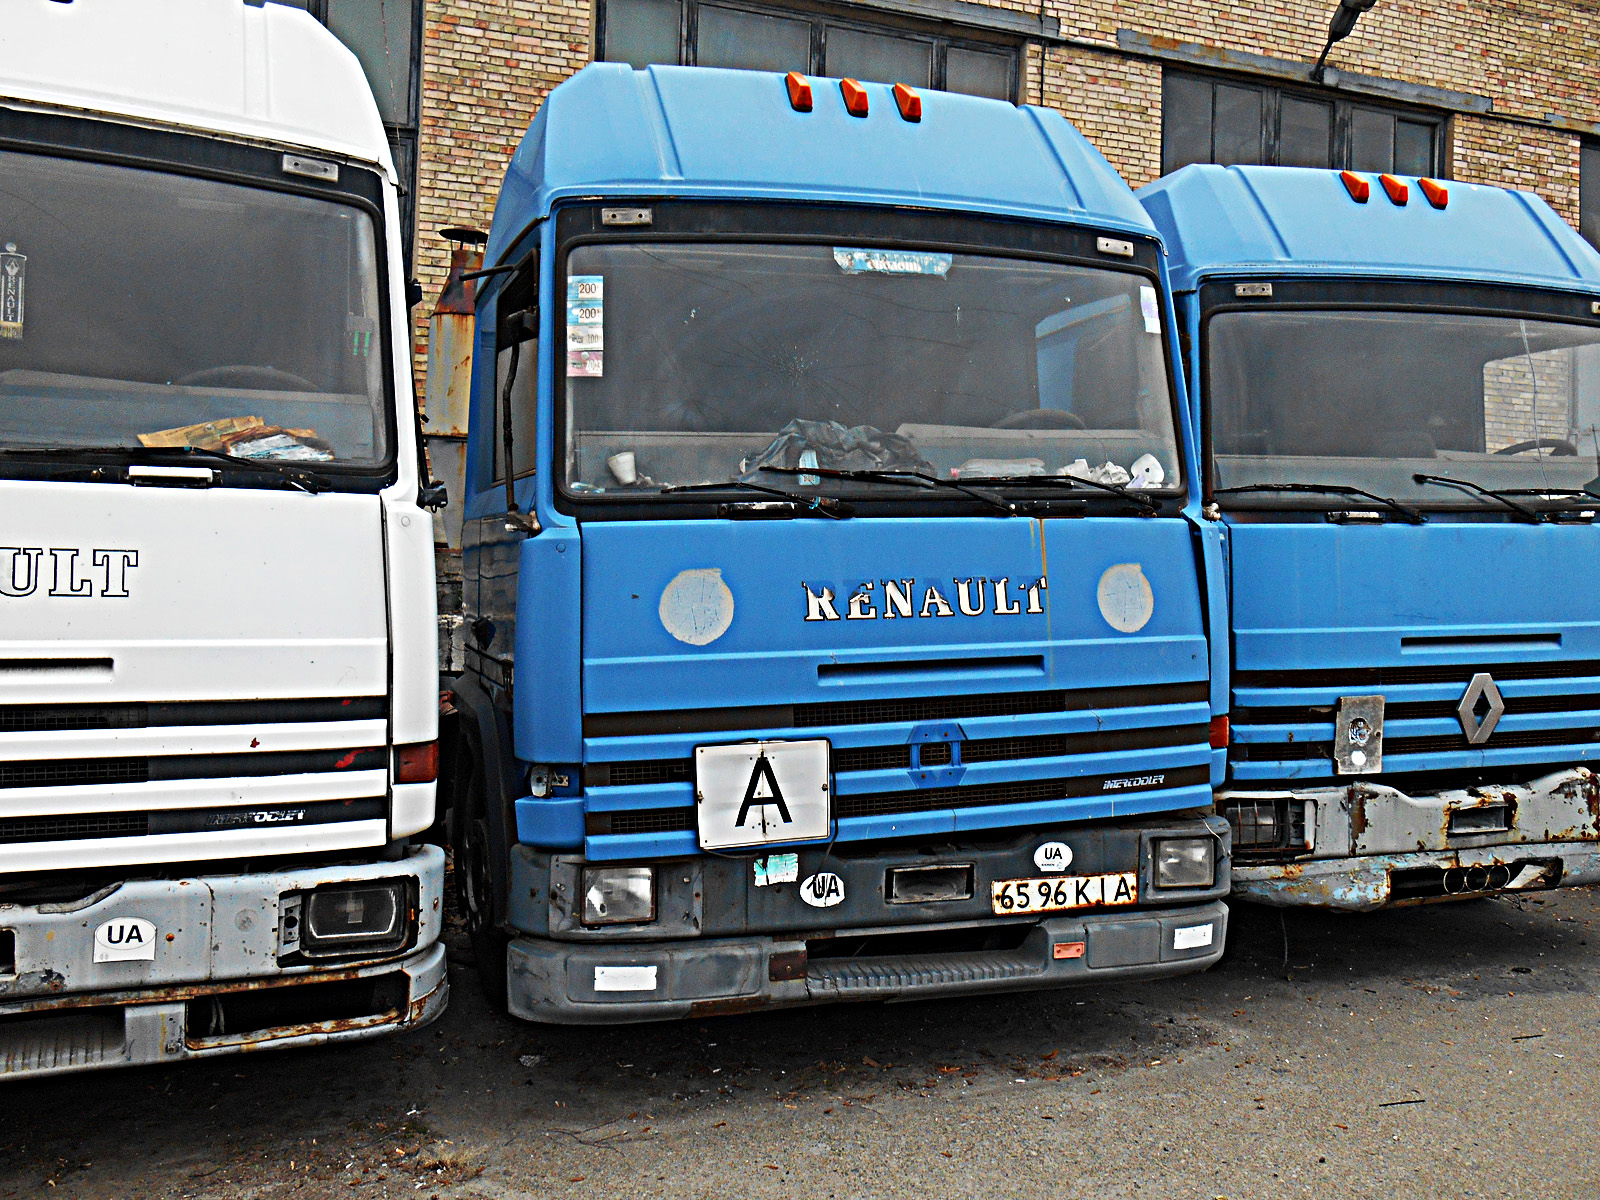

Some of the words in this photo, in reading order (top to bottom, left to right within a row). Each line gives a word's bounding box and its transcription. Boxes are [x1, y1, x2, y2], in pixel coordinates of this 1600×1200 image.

[0, 547, 138, 597] ULT
[802, 575, 1047, 621] RENAULT
[735, 755, 793, 828] A
[1044, 847, 1063, 860] UA
[808, 875, 841, 899] UA
[107, 925, 144, 944] UA
